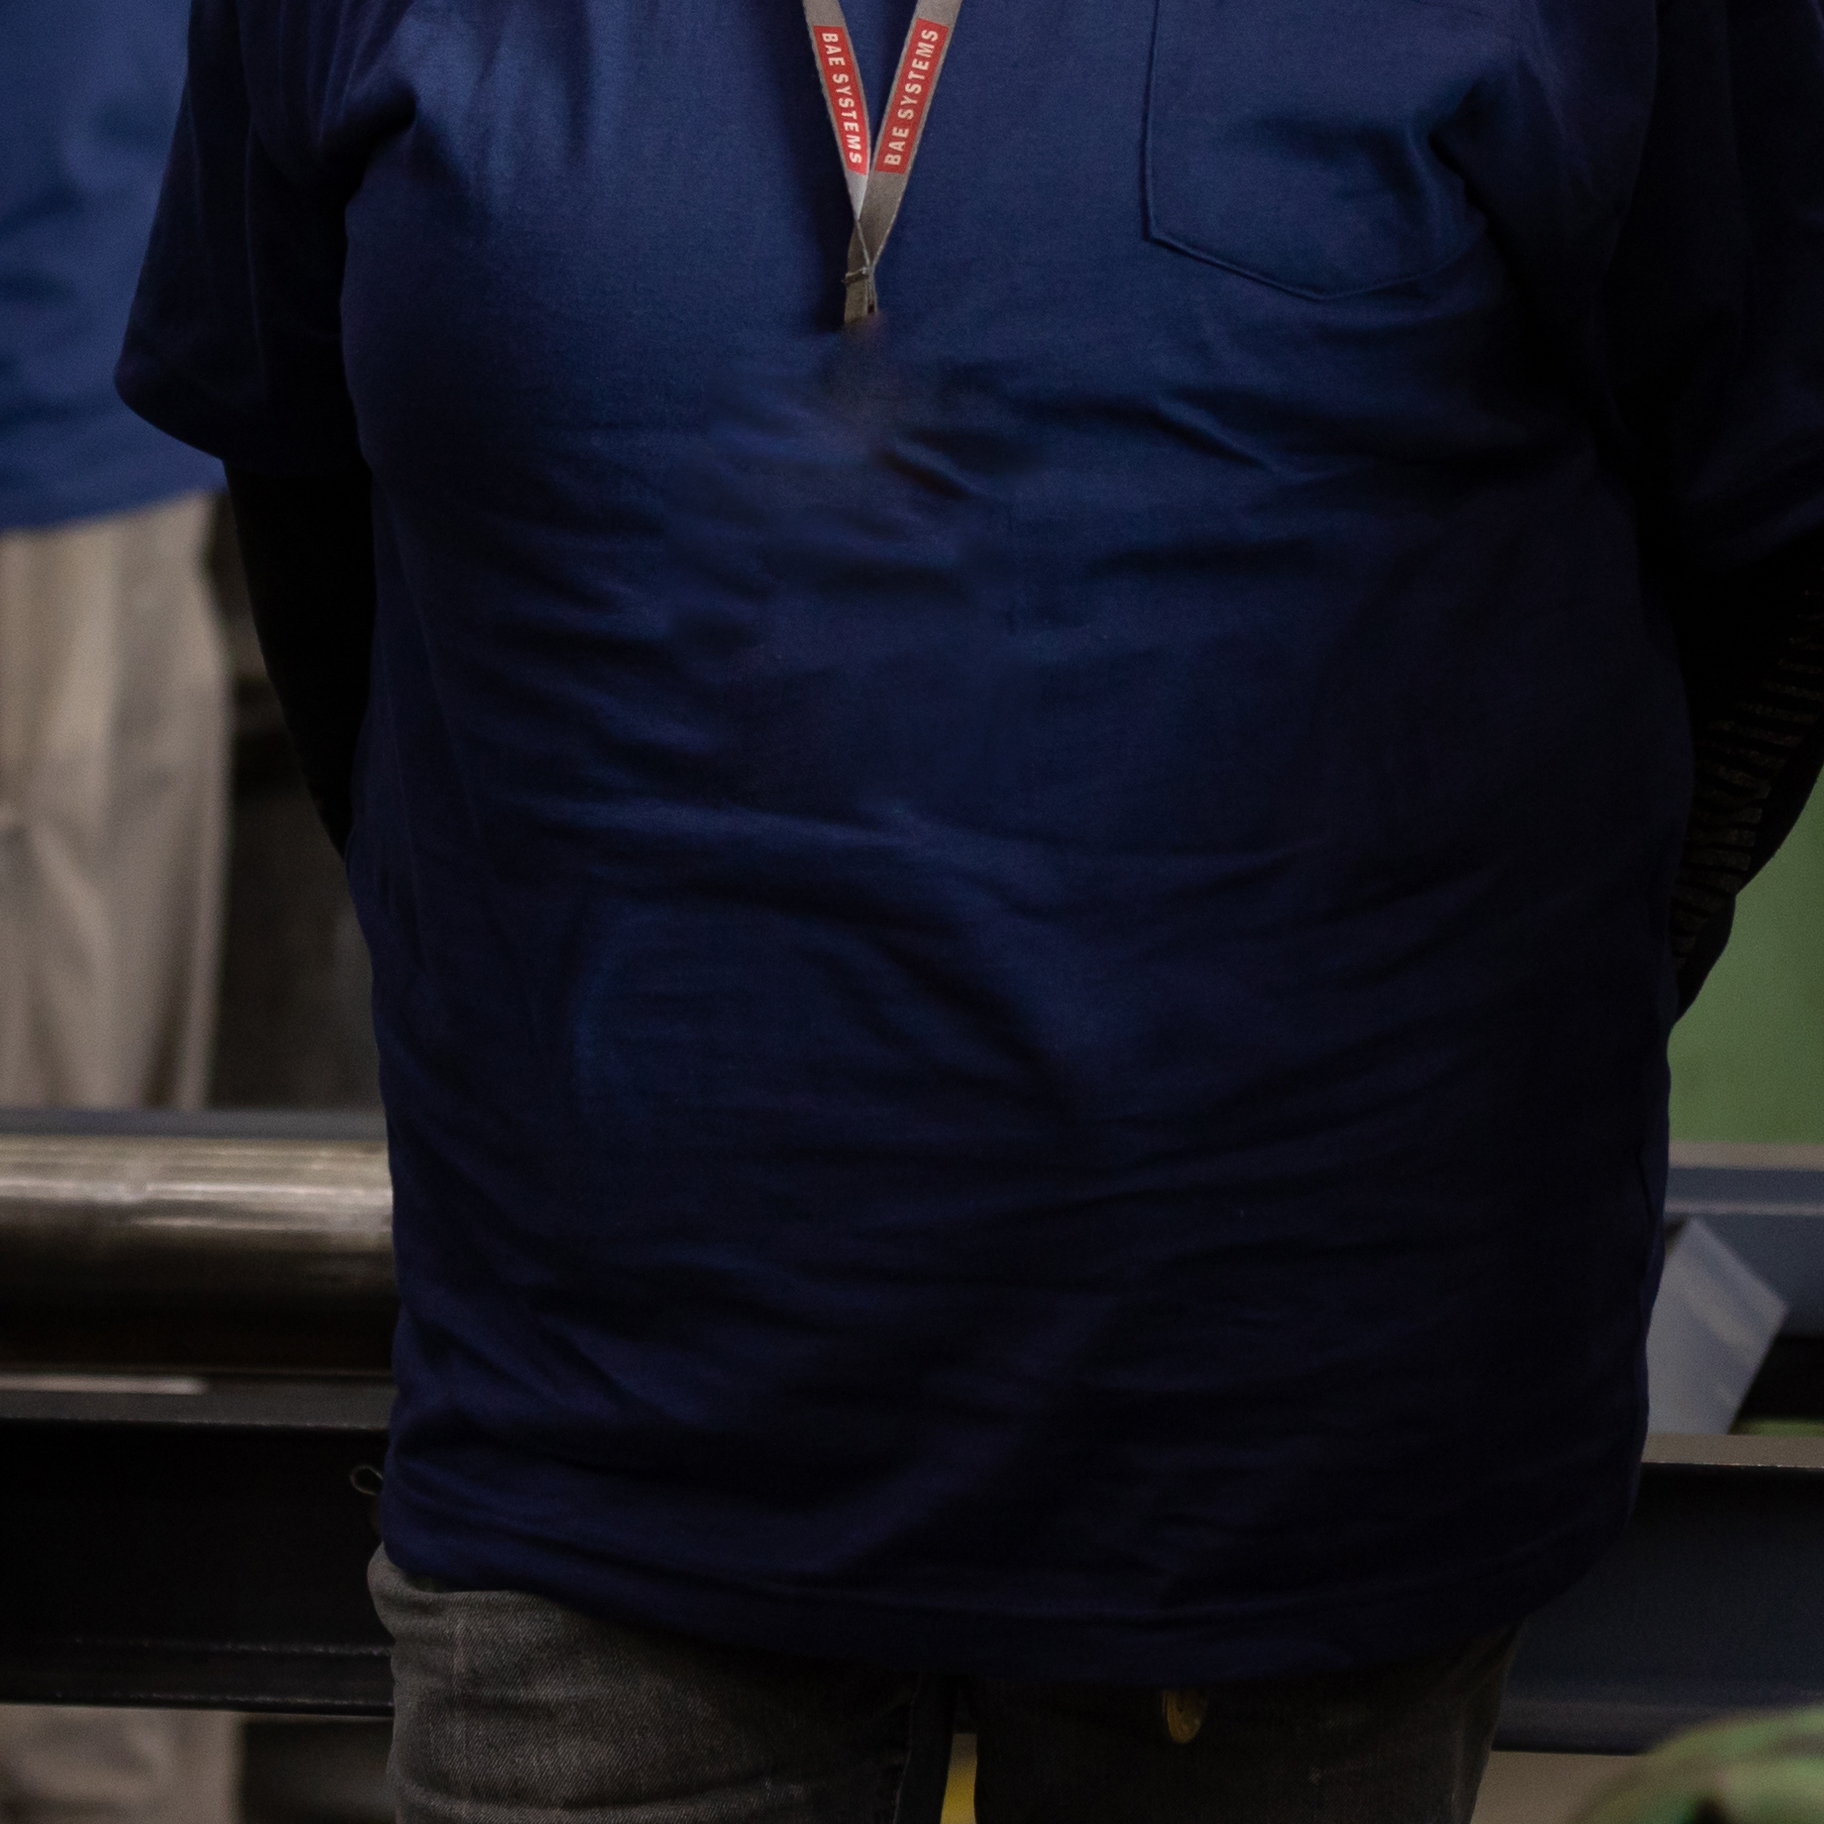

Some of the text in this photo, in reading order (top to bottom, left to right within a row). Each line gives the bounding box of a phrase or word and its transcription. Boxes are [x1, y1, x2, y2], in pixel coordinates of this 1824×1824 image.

[822, 32, 862, 164] BAE SYSTEMS
[884, 29, 938, 166] BAE SYSTEMS
